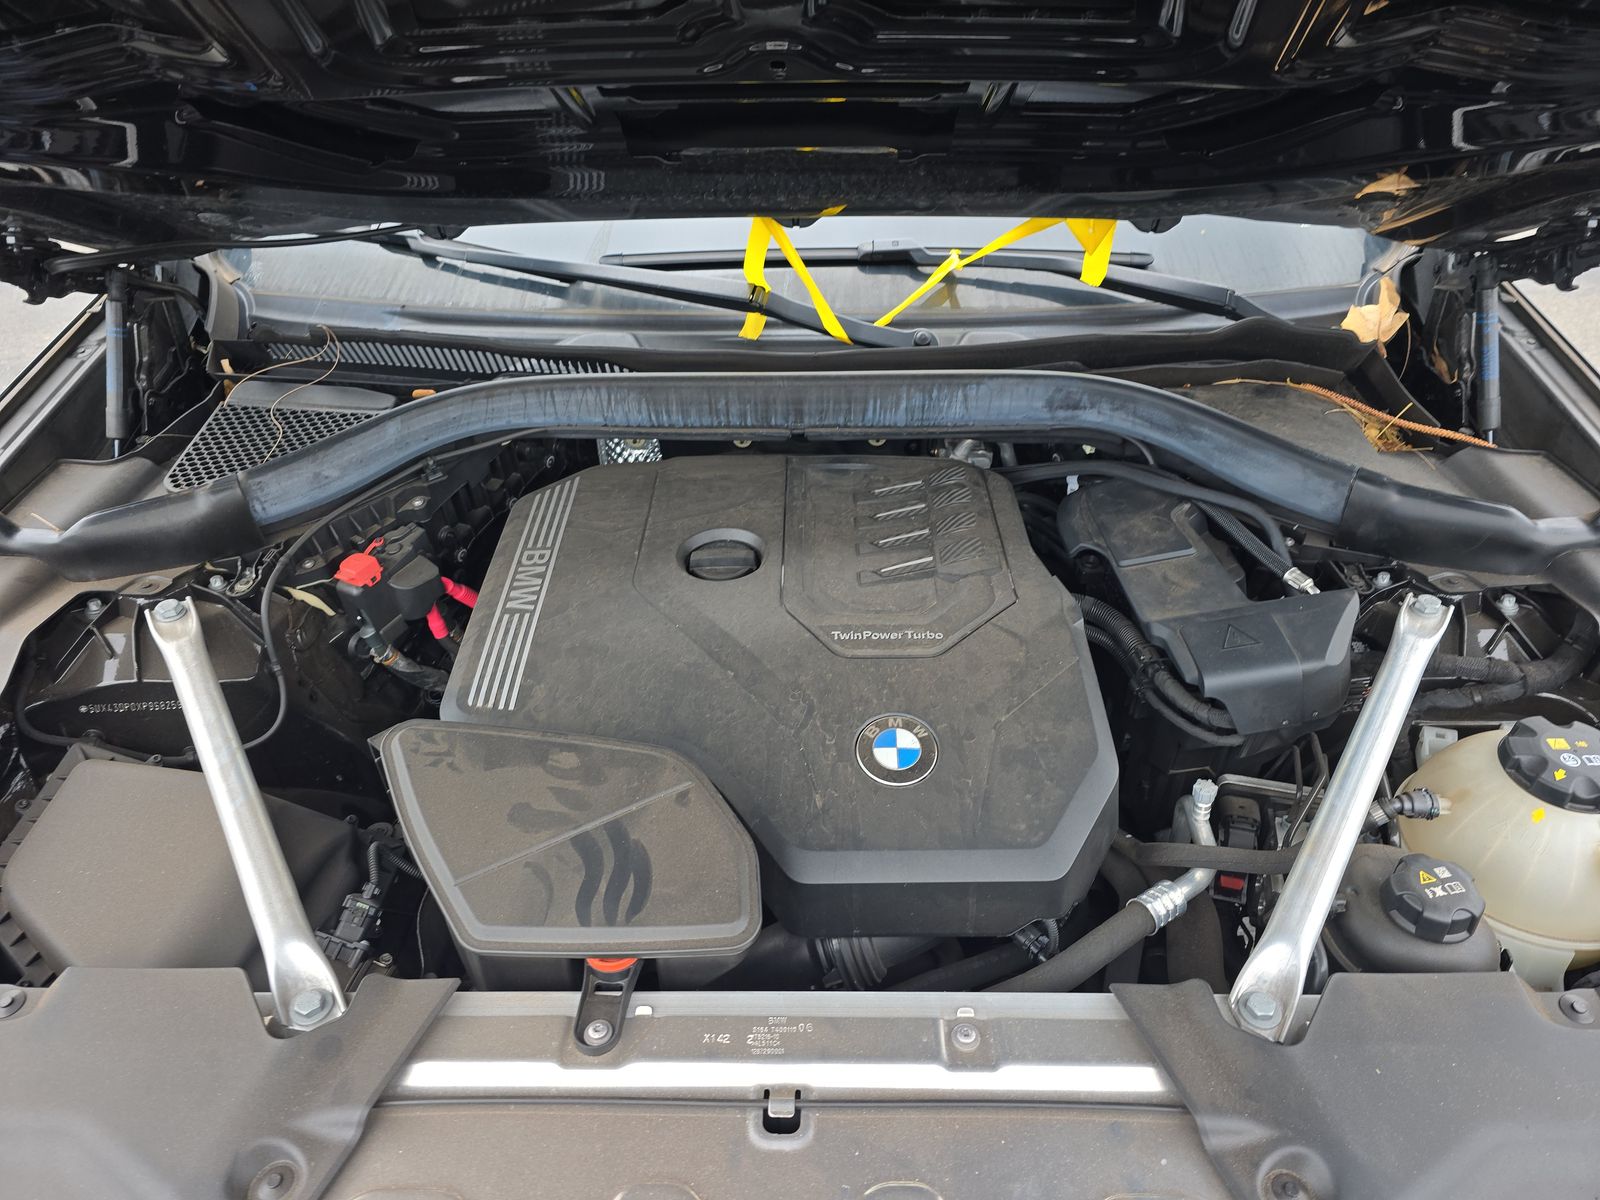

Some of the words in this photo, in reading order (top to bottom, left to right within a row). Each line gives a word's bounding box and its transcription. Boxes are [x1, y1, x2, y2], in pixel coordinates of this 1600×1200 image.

[505, 549, 551, 611] BMW
[831, 630, 903, 640] TwinPower
[904, 630, 944, 640] Turbo
[864, 718, 929, 739] BMW
[767, 1016, 787, 1025] BMW
